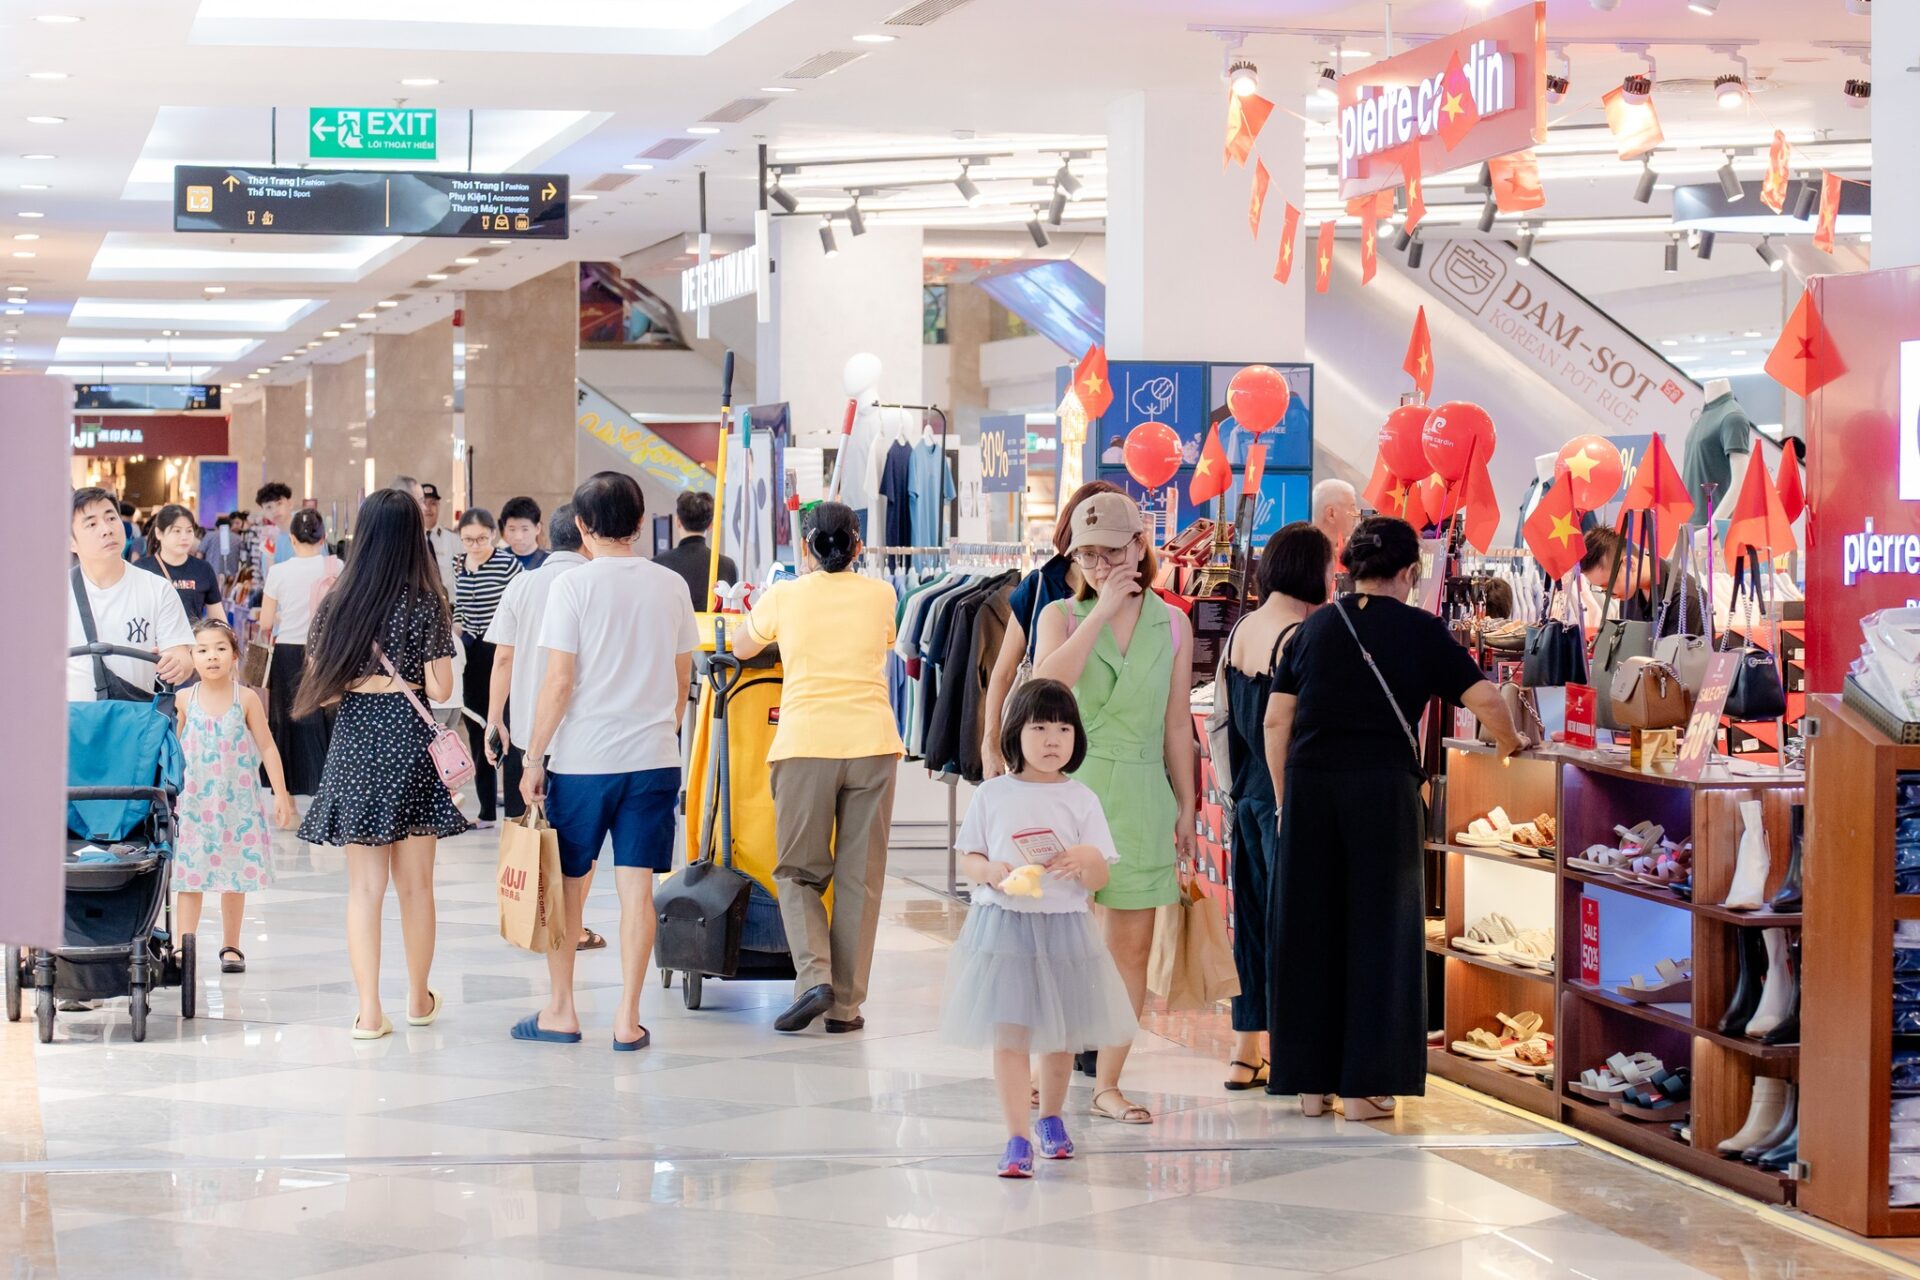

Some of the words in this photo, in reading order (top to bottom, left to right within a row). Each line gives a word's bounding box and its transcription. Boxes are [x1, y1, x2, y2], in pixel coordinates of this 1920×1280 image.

[1342, 84, 1412, 179] pierre
[1417, 39, 1503, 135] cadin
[367, 111, 433, 136] EXIT
[266, 188, 287, 197] Thao
[270, 177, 295, 187] Trang
[474, 181, 500, 191] Trang
[191, 196, 209, 208] L2
[452, 204, 478, 213] Thang
[1502, 280, 1657, 402] DAM-SOT
[1488, 308, 1561, 369] KOREAN
[1560, 361, 1598, 394] POT
[1596, 389, 1638, 427] RICE
[980, 430, 1008, 478] 30%
[1843, 517, 1920, 586] pierre
[127, 617, 150, 643] NY
[1699, 686, 1715, 702] SALE
[1714, 685, 1728, 700] OFF
[1680, 711, 1718, 761] 50%
[1583, 923, 1597, 942] SALE
[1582, 943, 1598, 970] 50%
